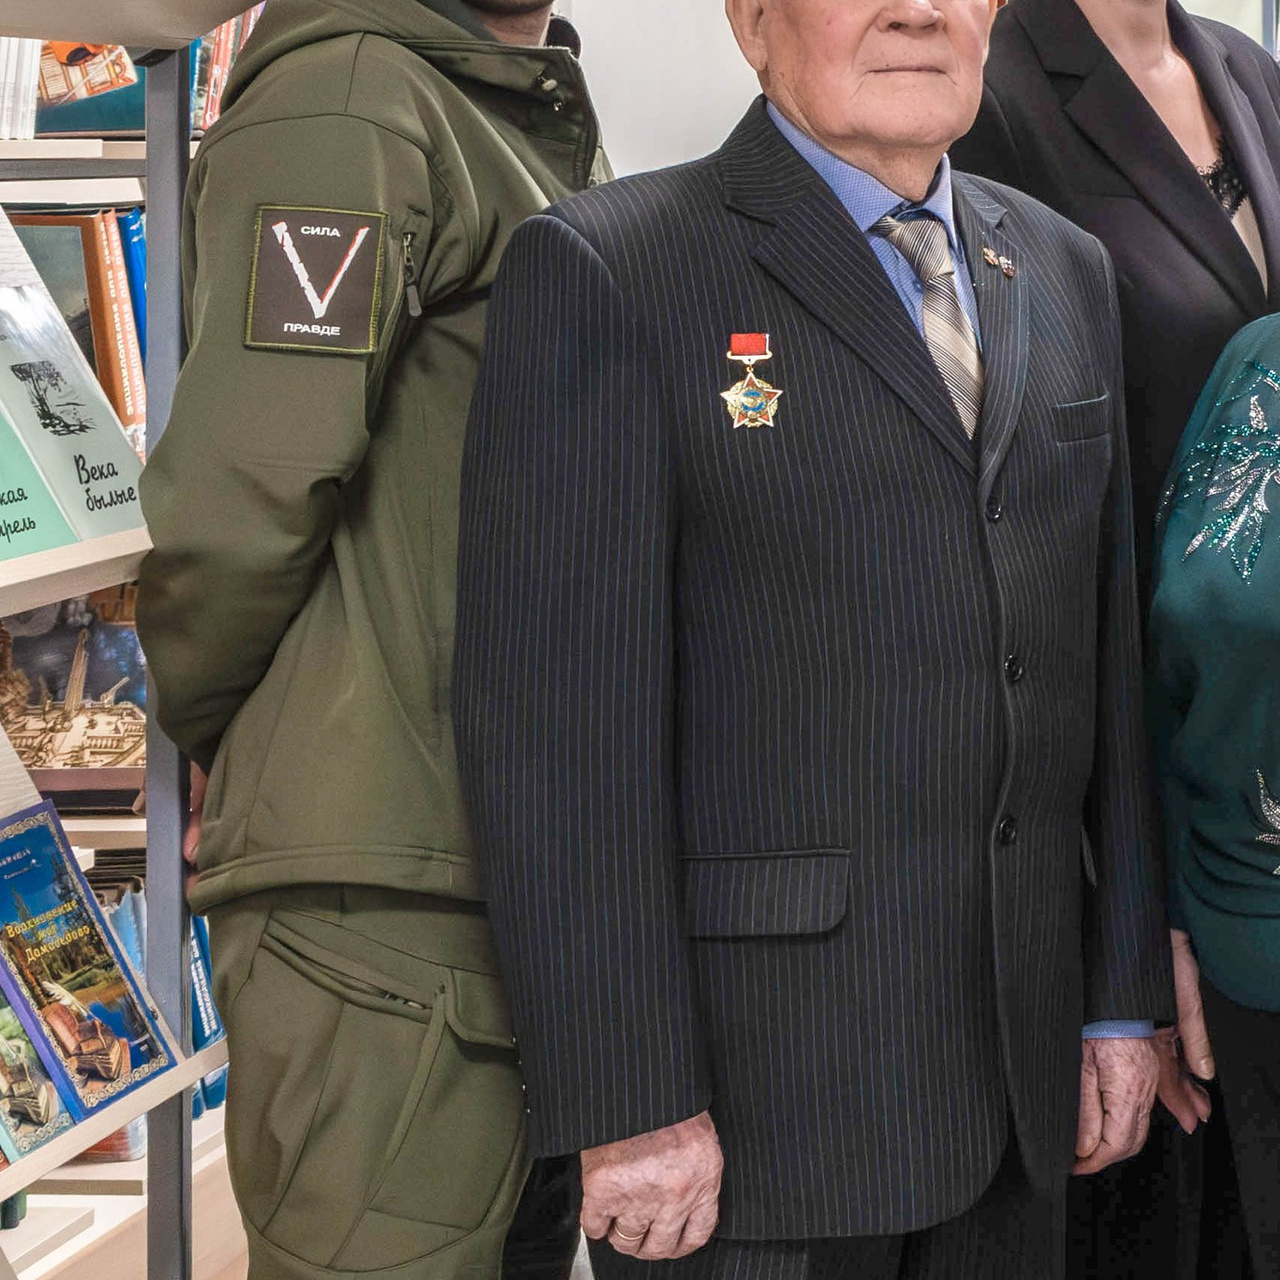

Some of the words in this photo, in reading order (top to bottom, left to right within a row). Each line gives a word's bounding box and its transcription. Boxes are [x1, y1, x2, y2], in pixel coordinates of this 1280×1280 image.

[300, 226, 341, 238] СИЛА
[272, 221, 370, 319] V
[283, 323, 341, 336] ПРАВДЕ
[73, 453, 119, 485] Века
[85, 486, 137, 511] былые
